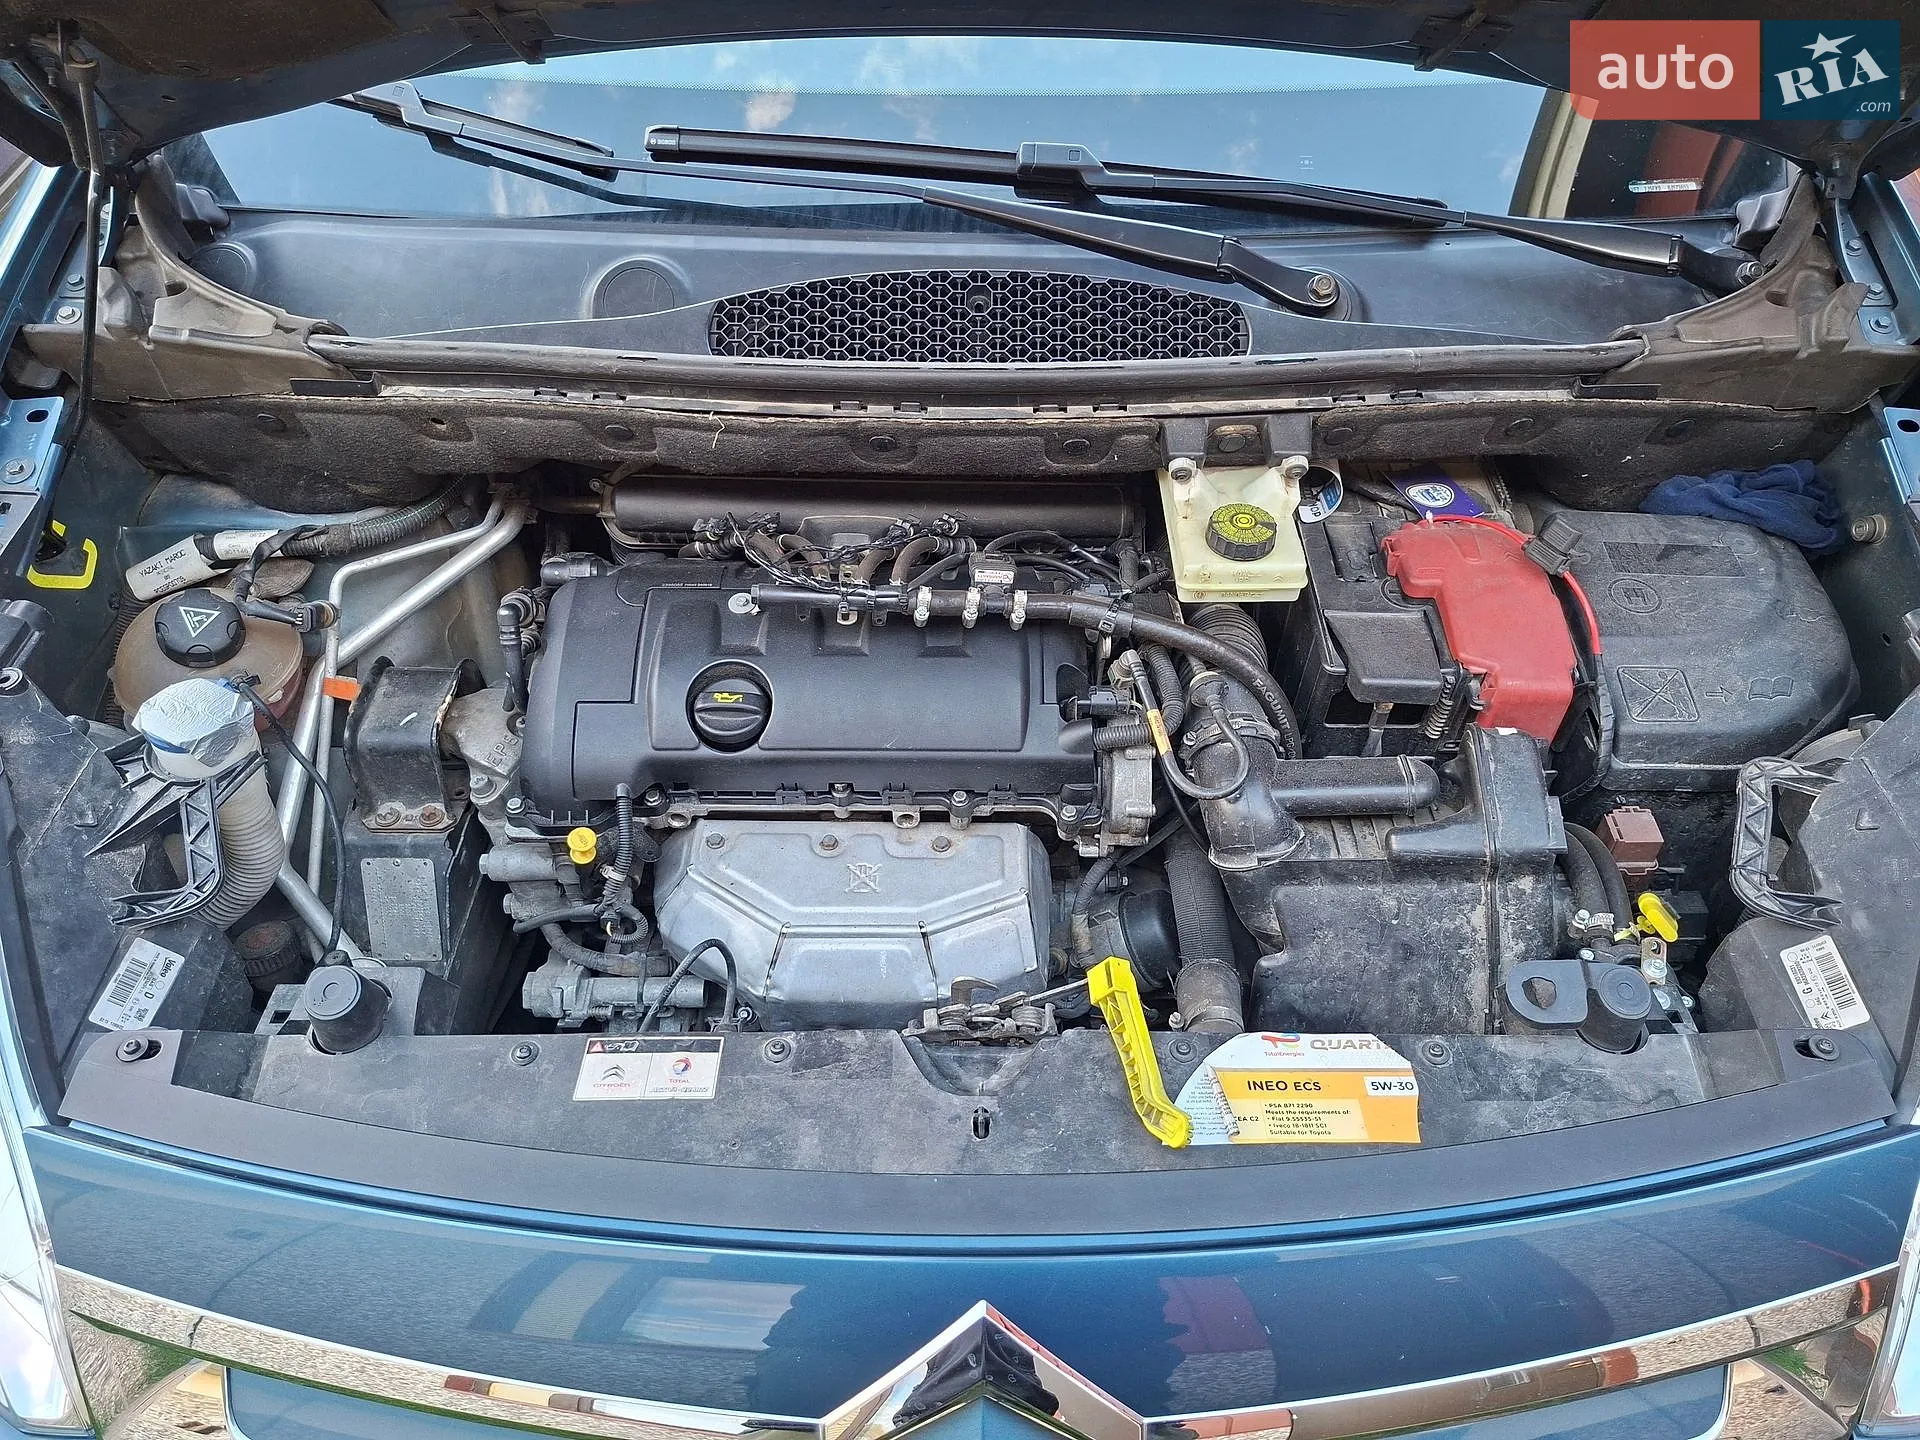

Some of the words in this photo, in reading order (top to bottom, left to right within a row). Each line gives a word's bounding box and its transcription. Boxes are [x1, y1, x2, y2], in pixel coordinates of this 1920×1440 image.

[138, 560, 164, 577] YAZAKI
[165, 549, 186, 566] MAROC
[1252, 678, 1290, 730] FAGUMIT
[1247, 1080, 1288, 1091] INEO
[1294, 1081, 1322, 1091] ECS
[1371, 1081, 1414, 1091] 5W-30
